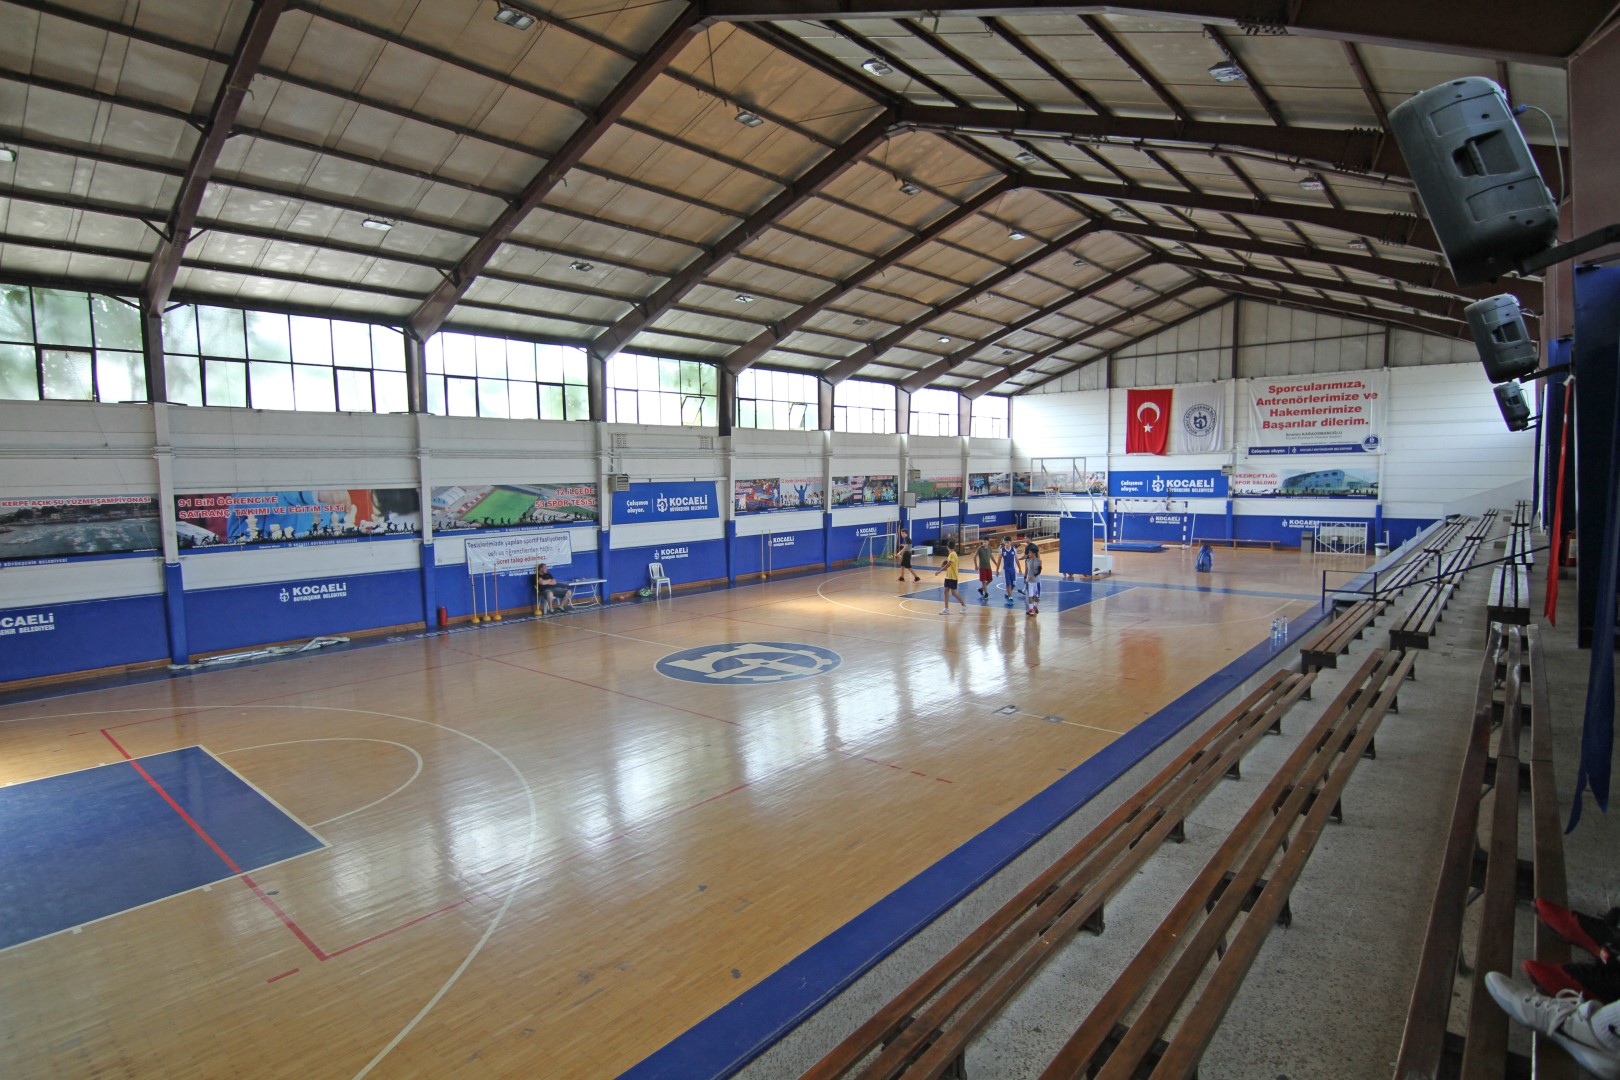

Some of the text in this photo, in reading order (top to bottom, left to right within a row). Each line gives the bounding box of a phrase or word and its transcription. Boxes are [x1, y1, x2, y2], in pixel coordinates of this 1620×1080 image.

[1268, 380, 1366, 395] Sporcularımıza,
[1256, 392, 1378, 406] Antrenörlerimize ve
[1270, 405, 1362, 417] Hakemlerimize
[1262, 417, 1369, 430] Başarılar dilerim.
[1166, 477, 1214, 488] KOCAELİ
[178, 498, 192, 508] 91
[547, 499, 570, 507] SPOR
[669, 495, 708, 506] KOCAELİ
[179, 509, 231, 520] SATRANÇ
[234, 508, 271, 518] TAKIMI
[273, 507, 287, 515] VE
[505, 538, 523, 547] yapılan
[523, 537, 539, 546] sportif
[661, 547, 689, 556] KOCAELİ
[292, 582, 347, 596] KOCAELİ
